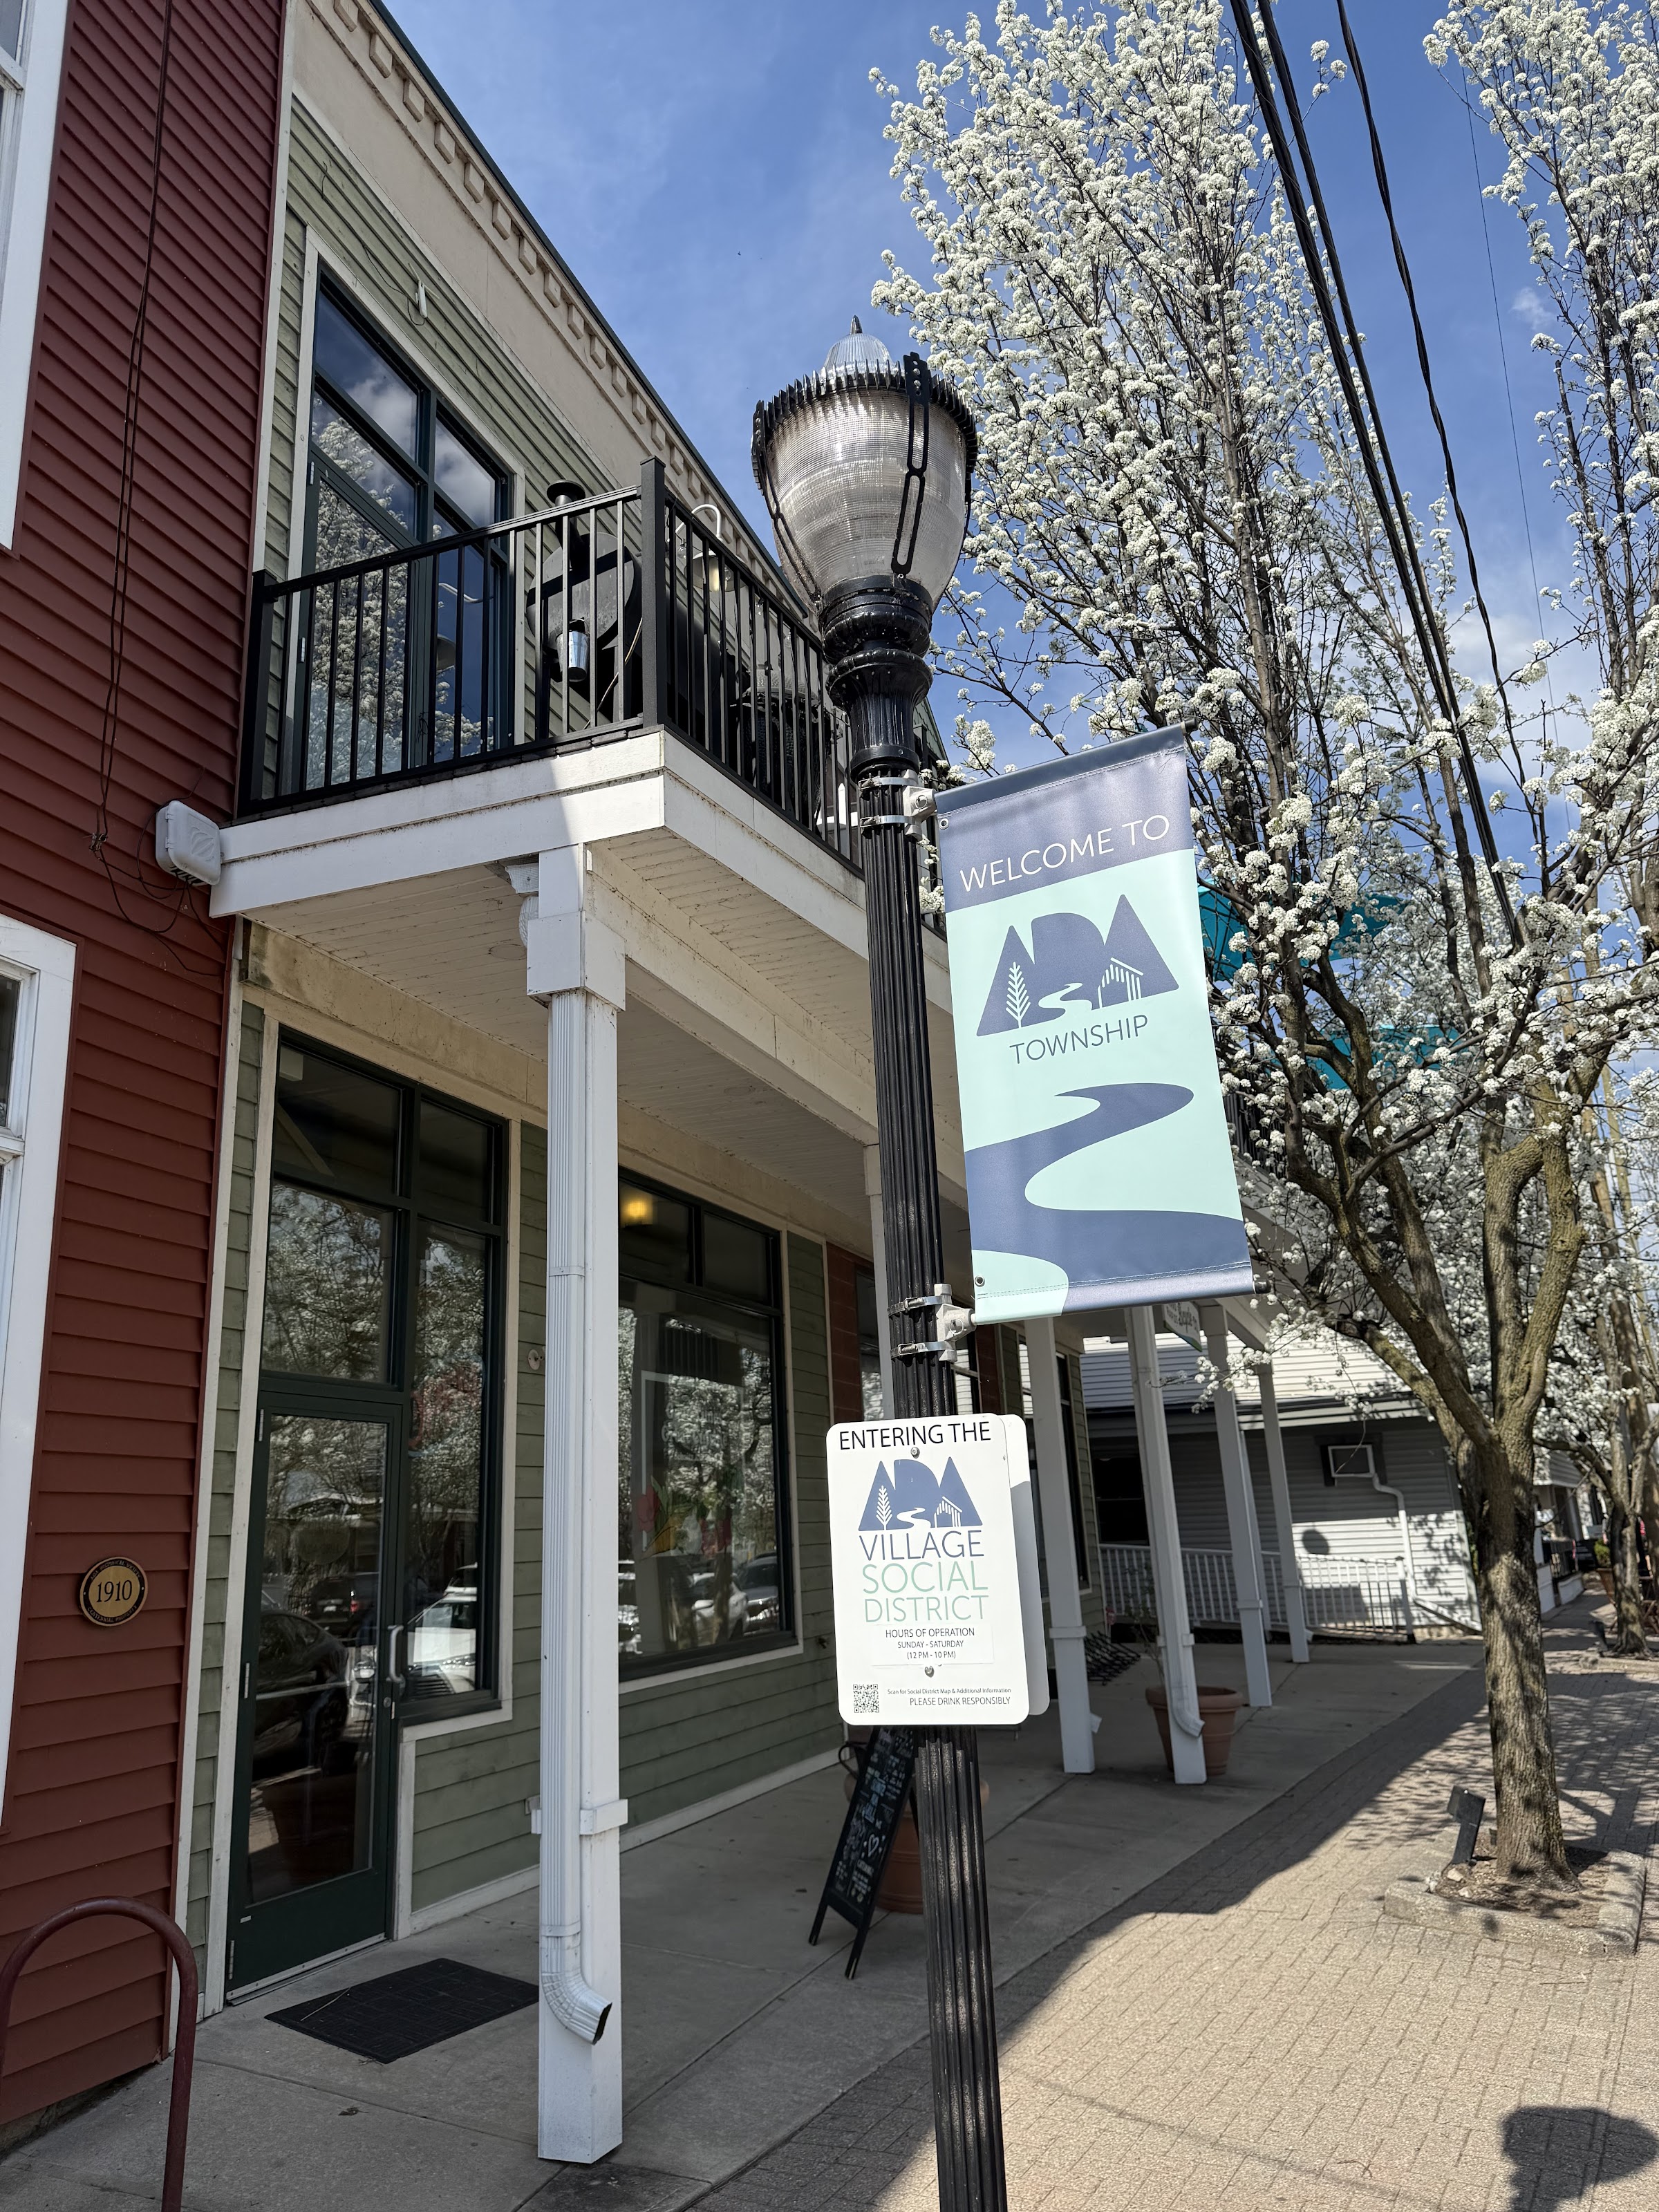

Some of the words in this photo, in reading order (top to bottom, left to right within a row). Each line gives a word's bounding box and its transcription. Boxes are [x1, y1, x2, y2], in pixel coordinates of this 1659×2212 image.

[959, 827, 1114, 892] WELCOME
[1121, 814, 1169, 845] TO
[976, 894, 1179, 1036] ADA
[1009, 1014, 1147, 1064] TOWNSHIP
[839, 1424, 944, 1450] ENTERING
[947, 1421, 991, 1441] THE
[858, 1456, 982, 1531] ADA
[859, 1530, 984, 1560] VILLAGE
[97, 1580, 132, 1602] 1910
[862, 1560, 988, 1593] SOCIAL
[865, 1595, 988, 1622] DISTRICT
[885, 1629, 913, 1638] HOURS
[928, 1627, 974, 1636] OPERATION
[910, 1697, 935, 1705] PLEASE
